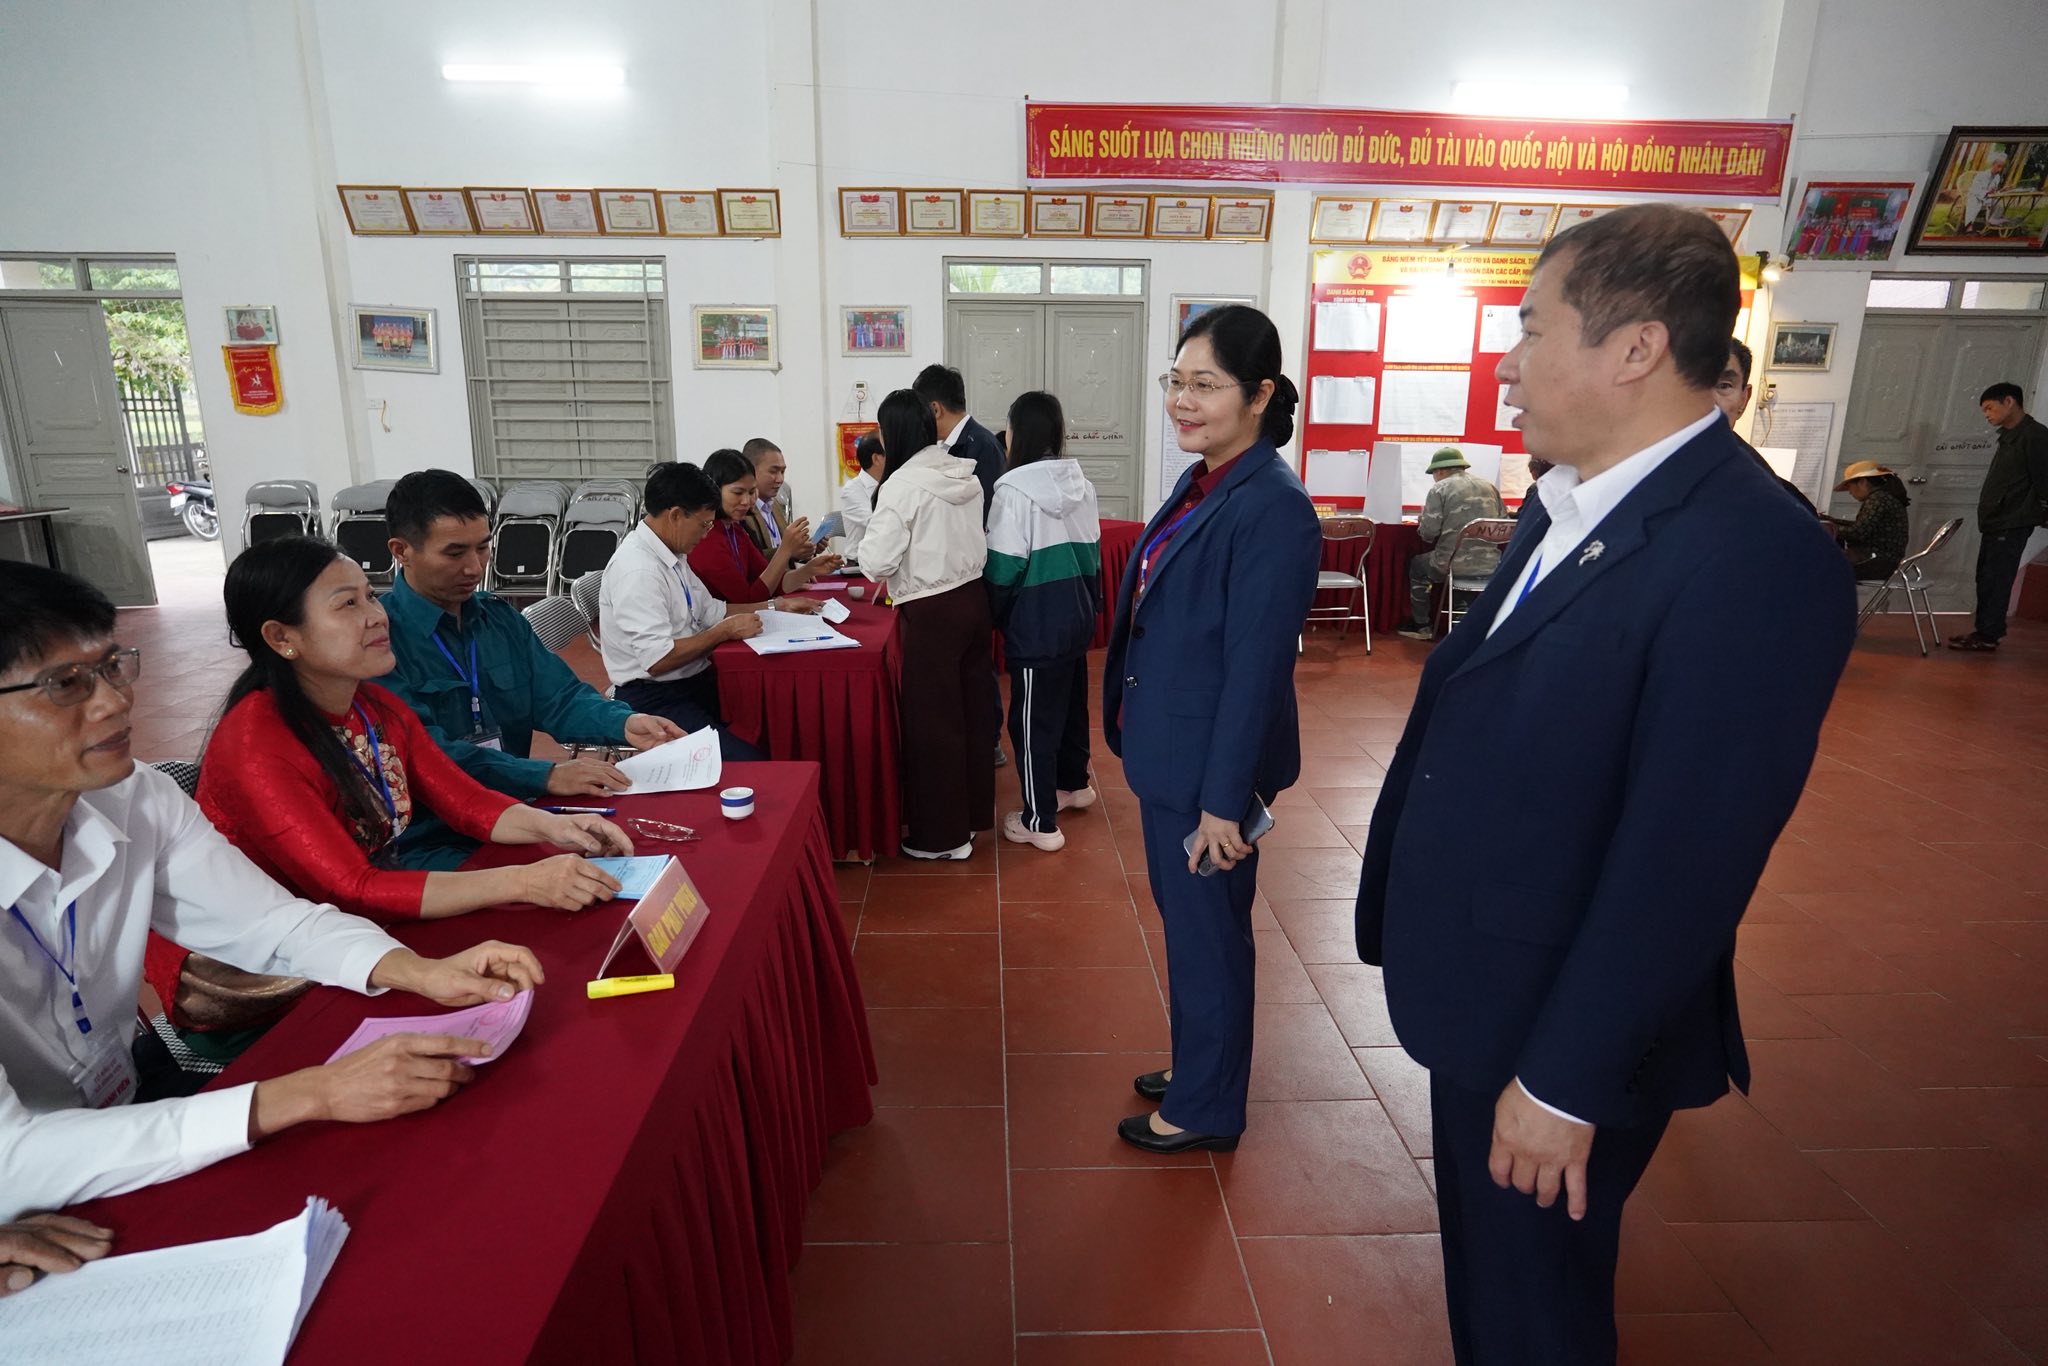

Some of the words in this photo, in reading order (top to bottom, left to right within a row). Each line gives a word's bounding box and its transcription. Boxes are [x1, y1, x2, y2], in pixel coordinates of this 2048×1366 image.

[1050, 125, 1094, 158] SÁNG
[1099, 121, 1140, 158] SUỐT
[1144, 129, 1174, 165] LỰA
[1180, 132, 1224, 165] CHỌN
[1229, 128, 1284, 162] NHỮNG
[1289, 128, 1338, 162] NGƯỜI
[1342, 126, 1364, 163] ĐỦ
[1368, 129, 1404, 167] ĐỨC,
[1409, 128, 1432, 164] ĐỦ
[1436, 136, 1460, 165] TÀI
[1465, 137, 1496, 167] VÀO
[1499, 131, 1542, 170] QUỐC
[1546, 137, 1572, 176] HỘI
[1577, 137, 1597, 171] VÀ
[1601, 138, 1627, 178] HỘI
[1630, 135, 1674, 173] ĐỒNG
[1678, 142, 1723, 175] NHÂN
[1726, 142, 1766, 176] DÂN!
